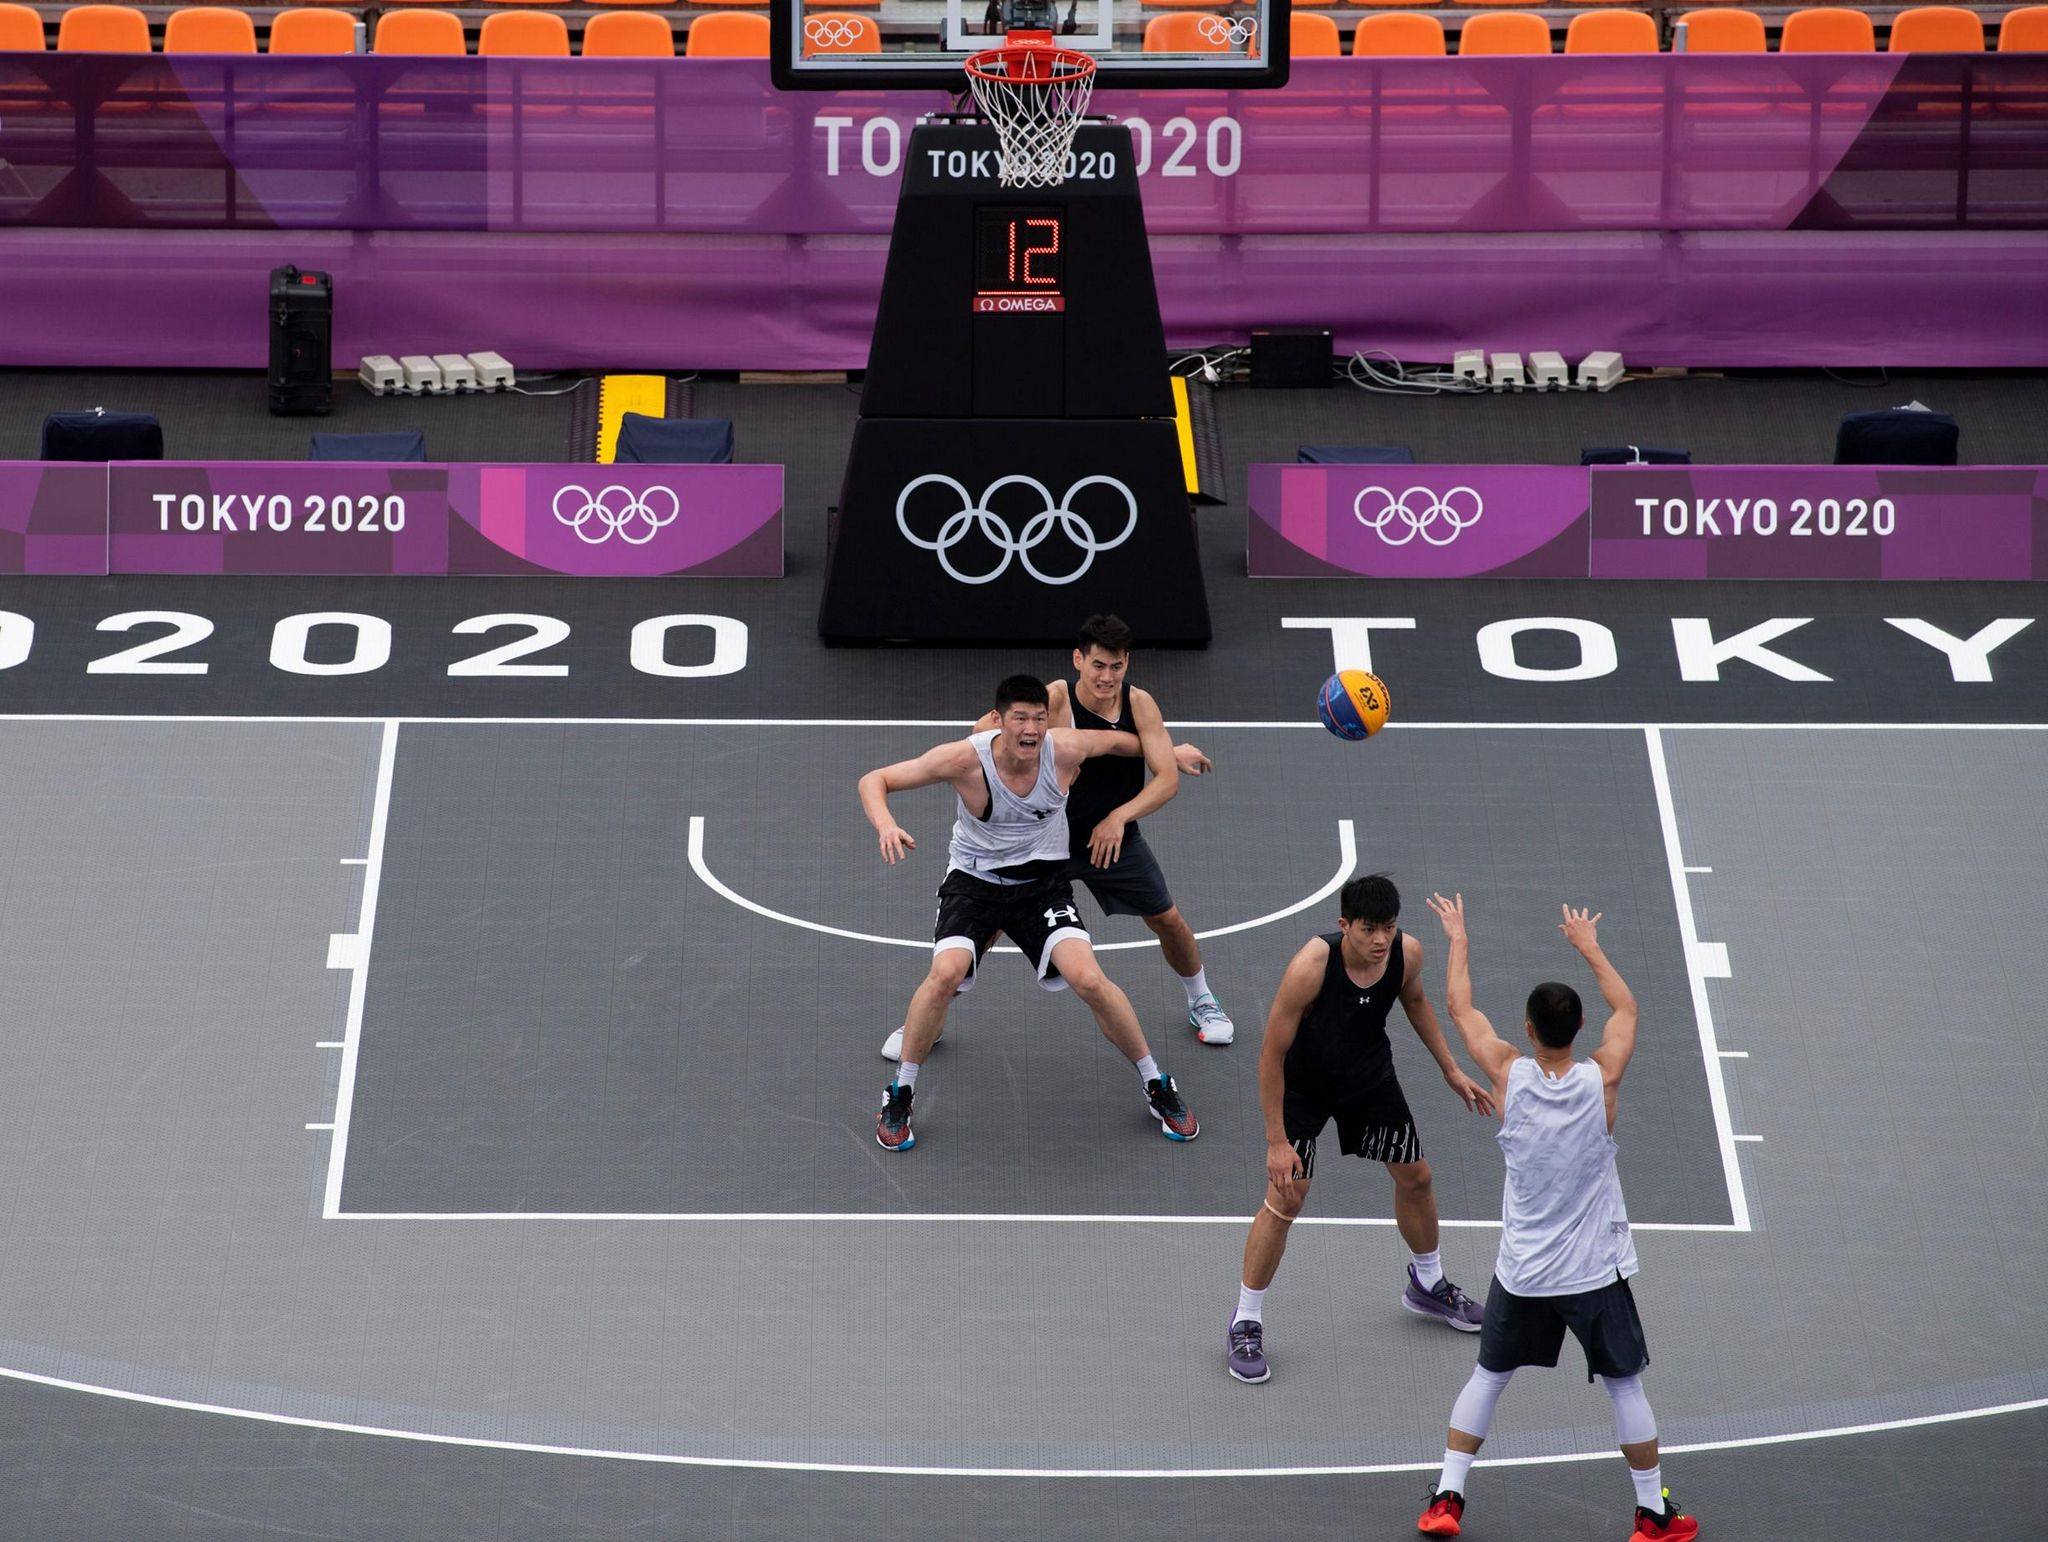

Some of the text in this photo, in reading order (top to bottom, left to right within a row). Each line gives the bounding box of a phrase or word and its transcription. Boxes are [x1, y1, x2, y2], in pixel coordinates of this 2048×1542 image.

[1080, 116, 1242, 178] 020
[1009, 219, 1059, 284] 12
[998, 298, 1057, 311] OMEGA
[152, 494, 405, 533] TOKYO 2020
[1635, 498, 1895, 536] TOKYO 2020
[86, 610, 749, 677] 2020
